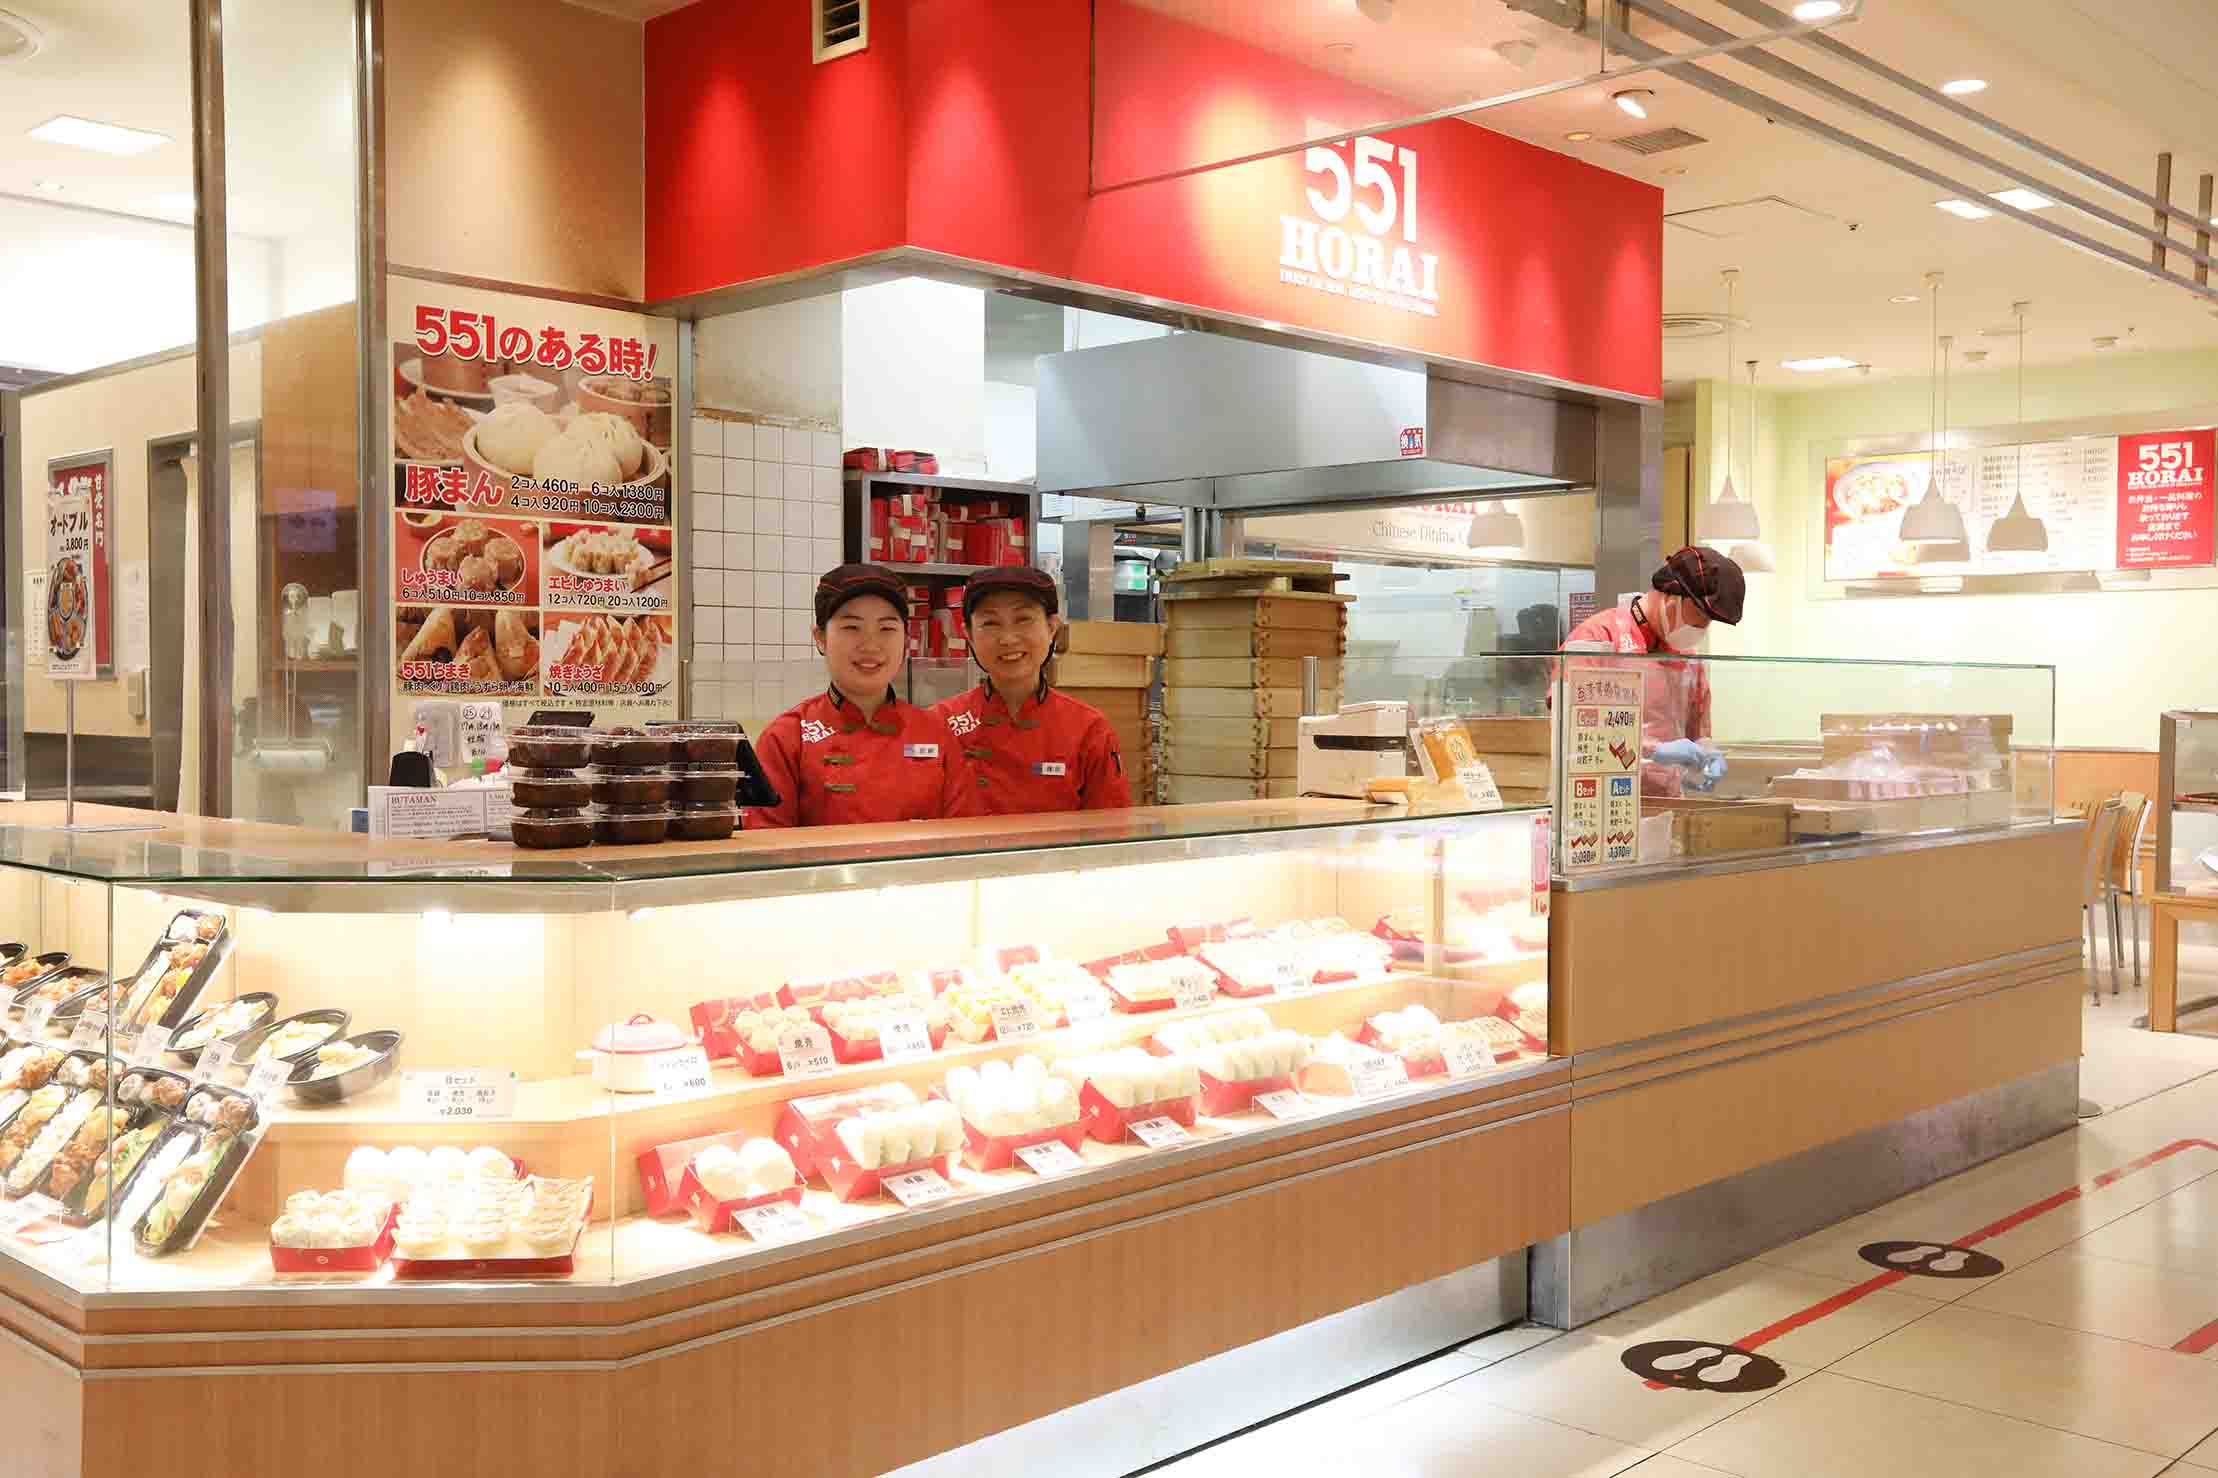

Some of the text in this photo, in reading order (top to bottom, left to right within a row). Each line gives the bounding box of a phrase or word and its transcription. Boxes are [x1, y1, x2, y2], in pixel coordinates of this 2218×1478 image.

[1304, 118, 1418, 243] 551
[1279, 214, 1440, 303] HORAI
[415, 304, 657, 380] 551のある時!
[2138, 441, 2193, 471] 551
[405, 464, 504, 506] 豚まん
[2127, 467, 2204, 485] HORAI
[50, 511, 89, 537] オードブル
[402, 568, 463, 585] しゅうまい
[548, 575, 627, 593] エビしゅうまい
[402, 661, 472, 680] 551ちまき
[549, 664, 604, 681] 焼ぎょうざ
